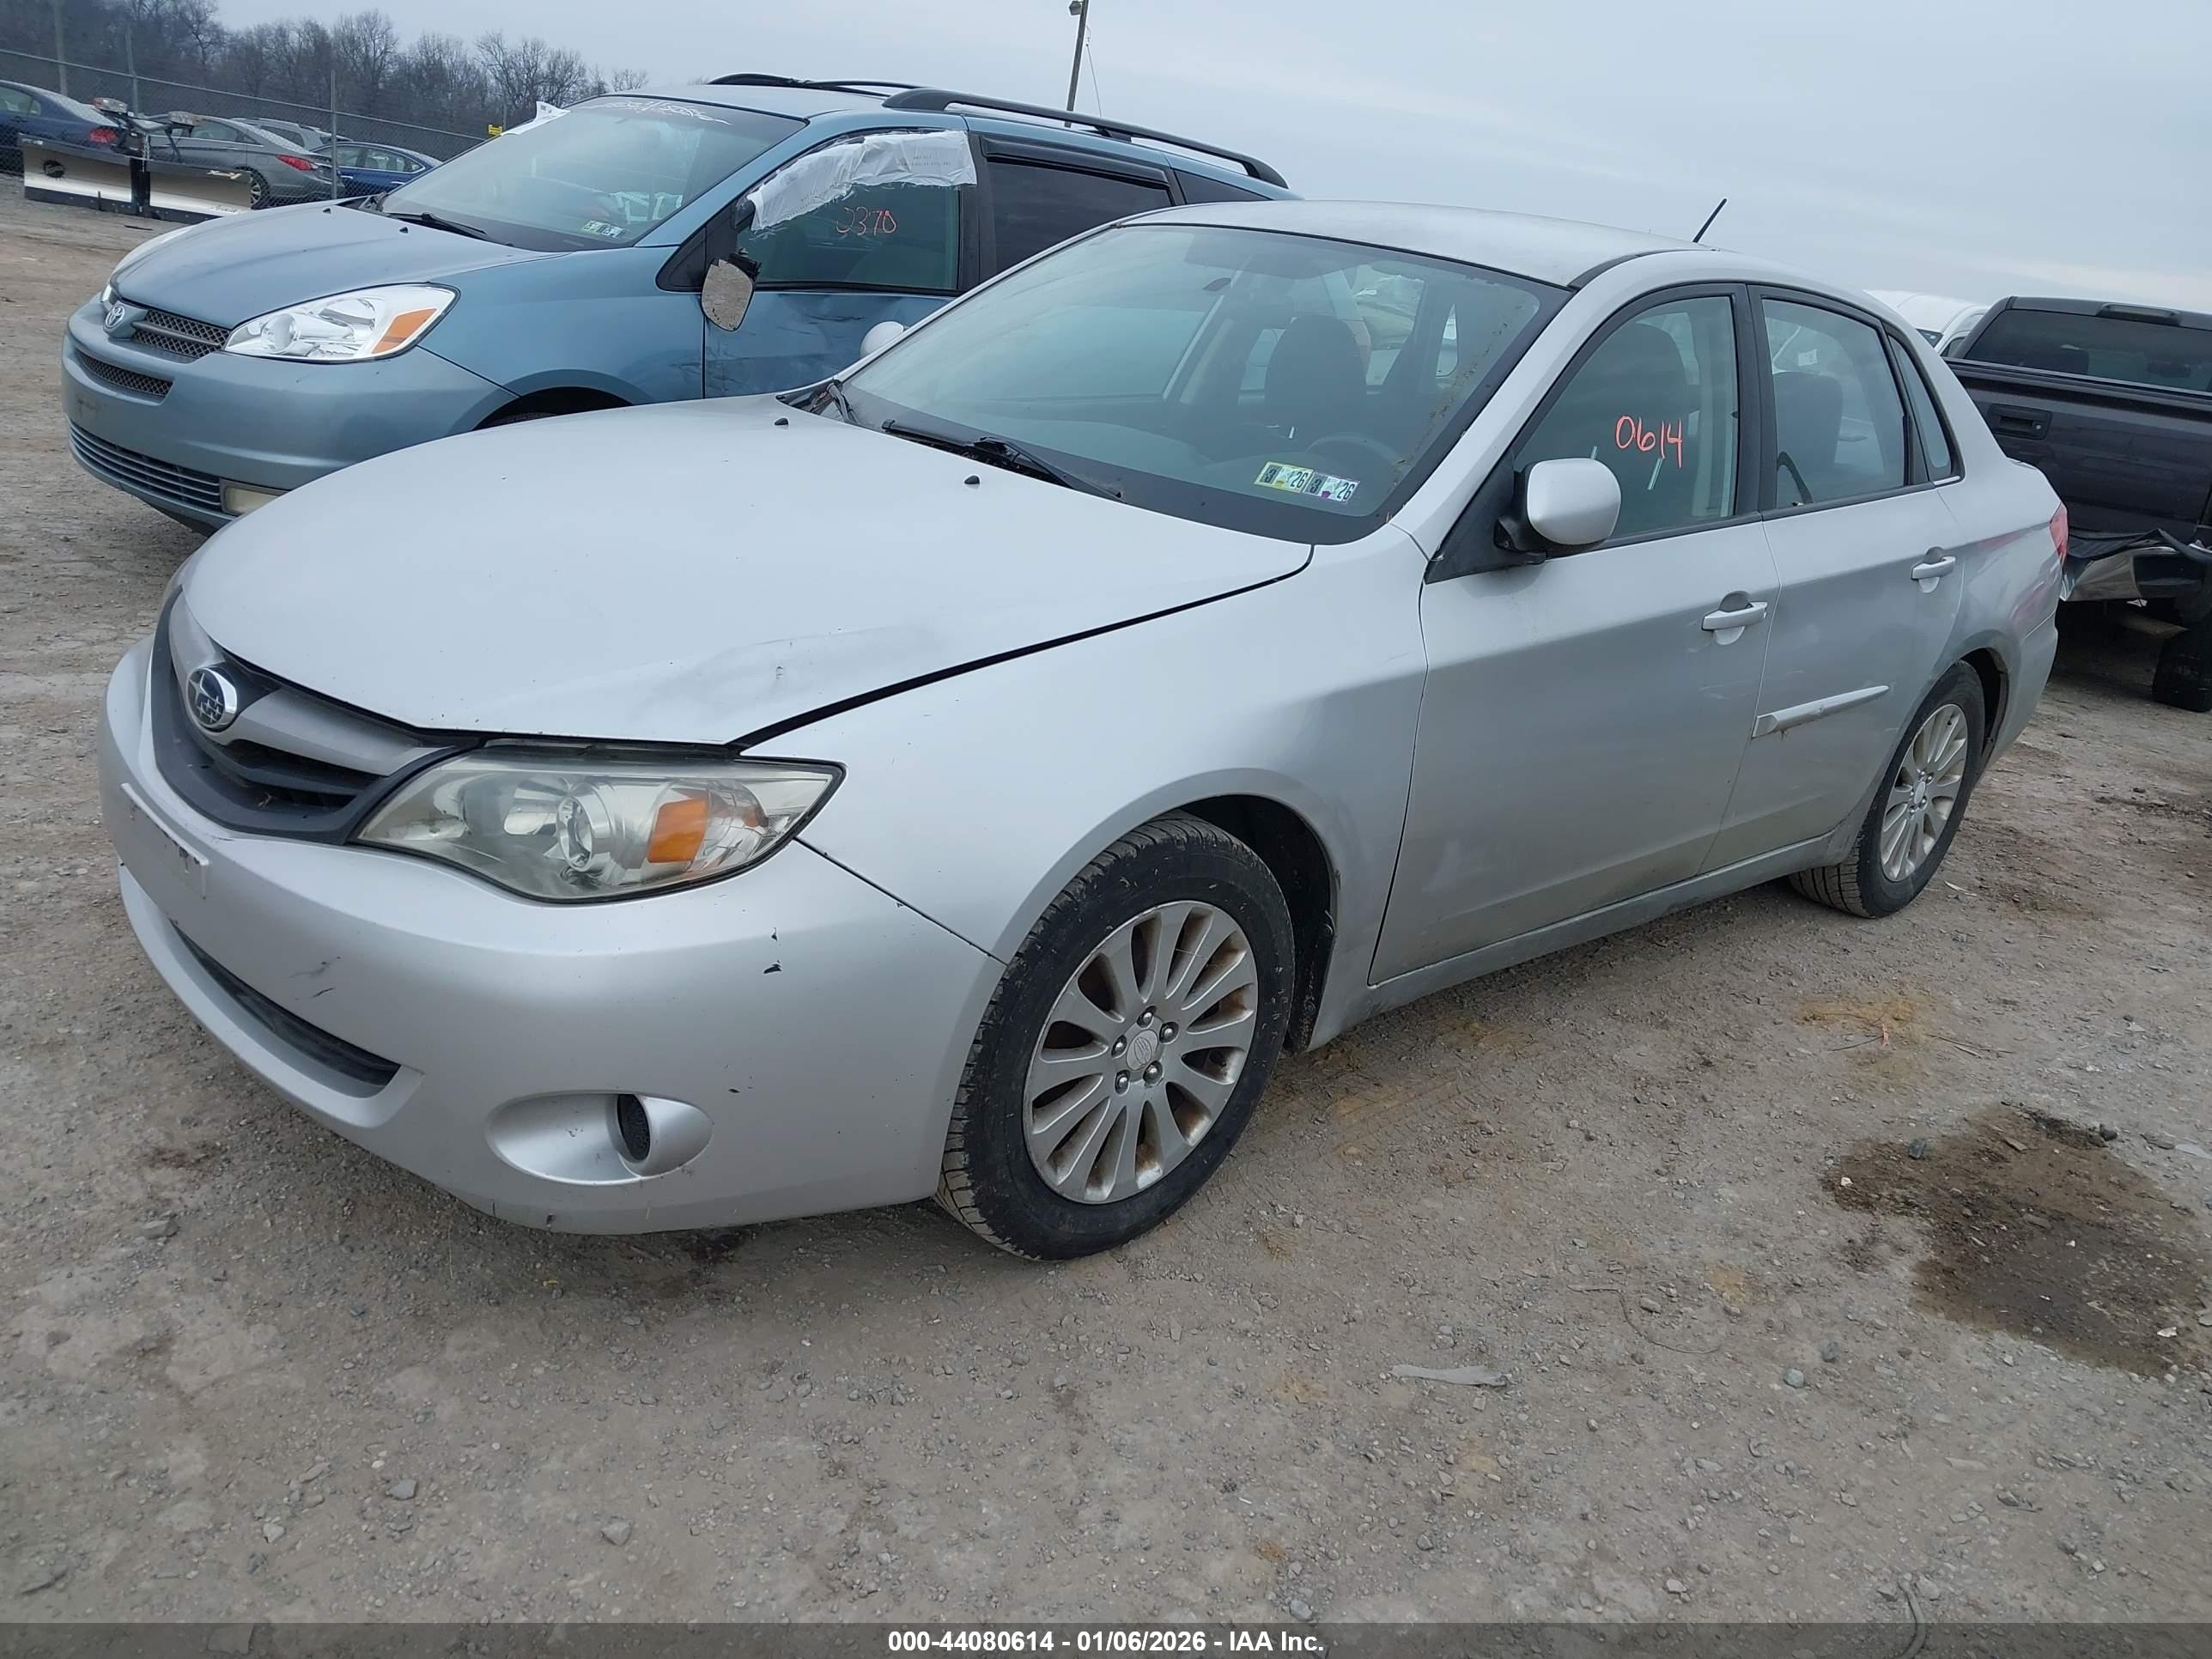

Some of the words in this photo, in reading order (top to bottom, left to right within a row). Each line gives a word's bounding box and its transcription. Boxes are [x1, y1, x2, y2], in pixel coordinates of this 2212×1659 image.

[1616, 415, 1682, 468] 0614
[1264, 468, 1277, 483] 3
[1310, 478, 1322, 494] 3
